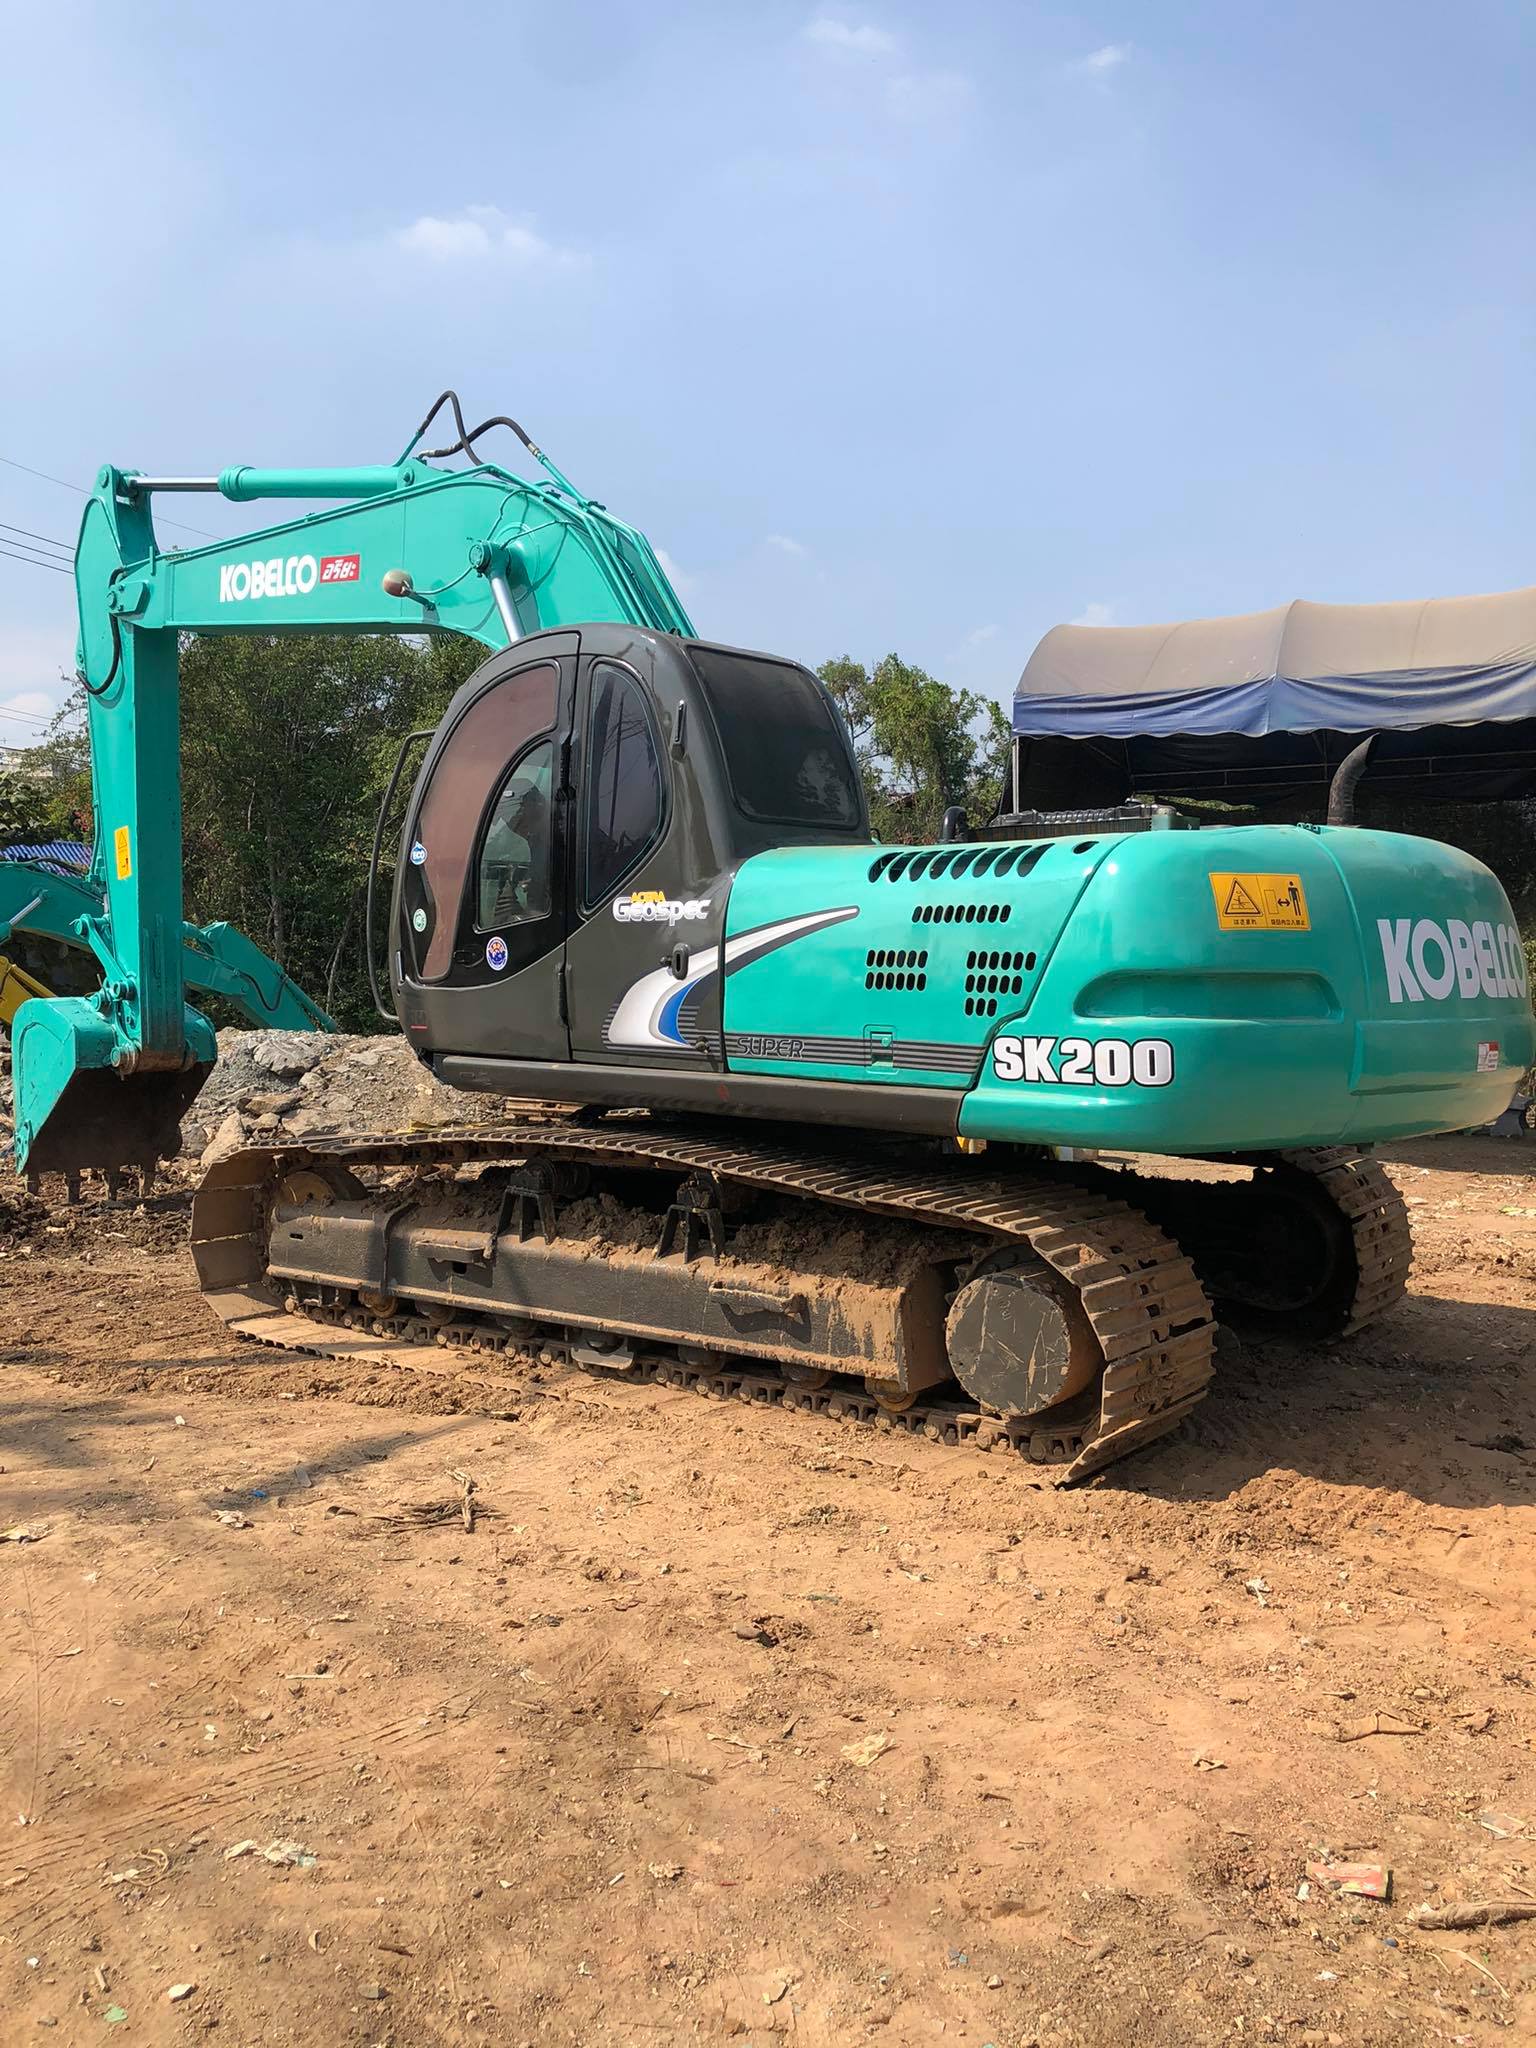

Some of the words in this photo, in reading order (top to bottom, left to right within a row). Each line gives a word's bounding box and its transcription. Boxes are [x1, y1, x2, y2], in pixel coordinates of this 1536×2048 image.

[220, 554, 318, 603] KOBELCO
[613, 896, 711, 926] Geospec
[1376, 918, 1527, 1004] KOBELCO
[737, 1036, 805, 1059] SUPER
[993, 1035, 1175, 1088] SK200
